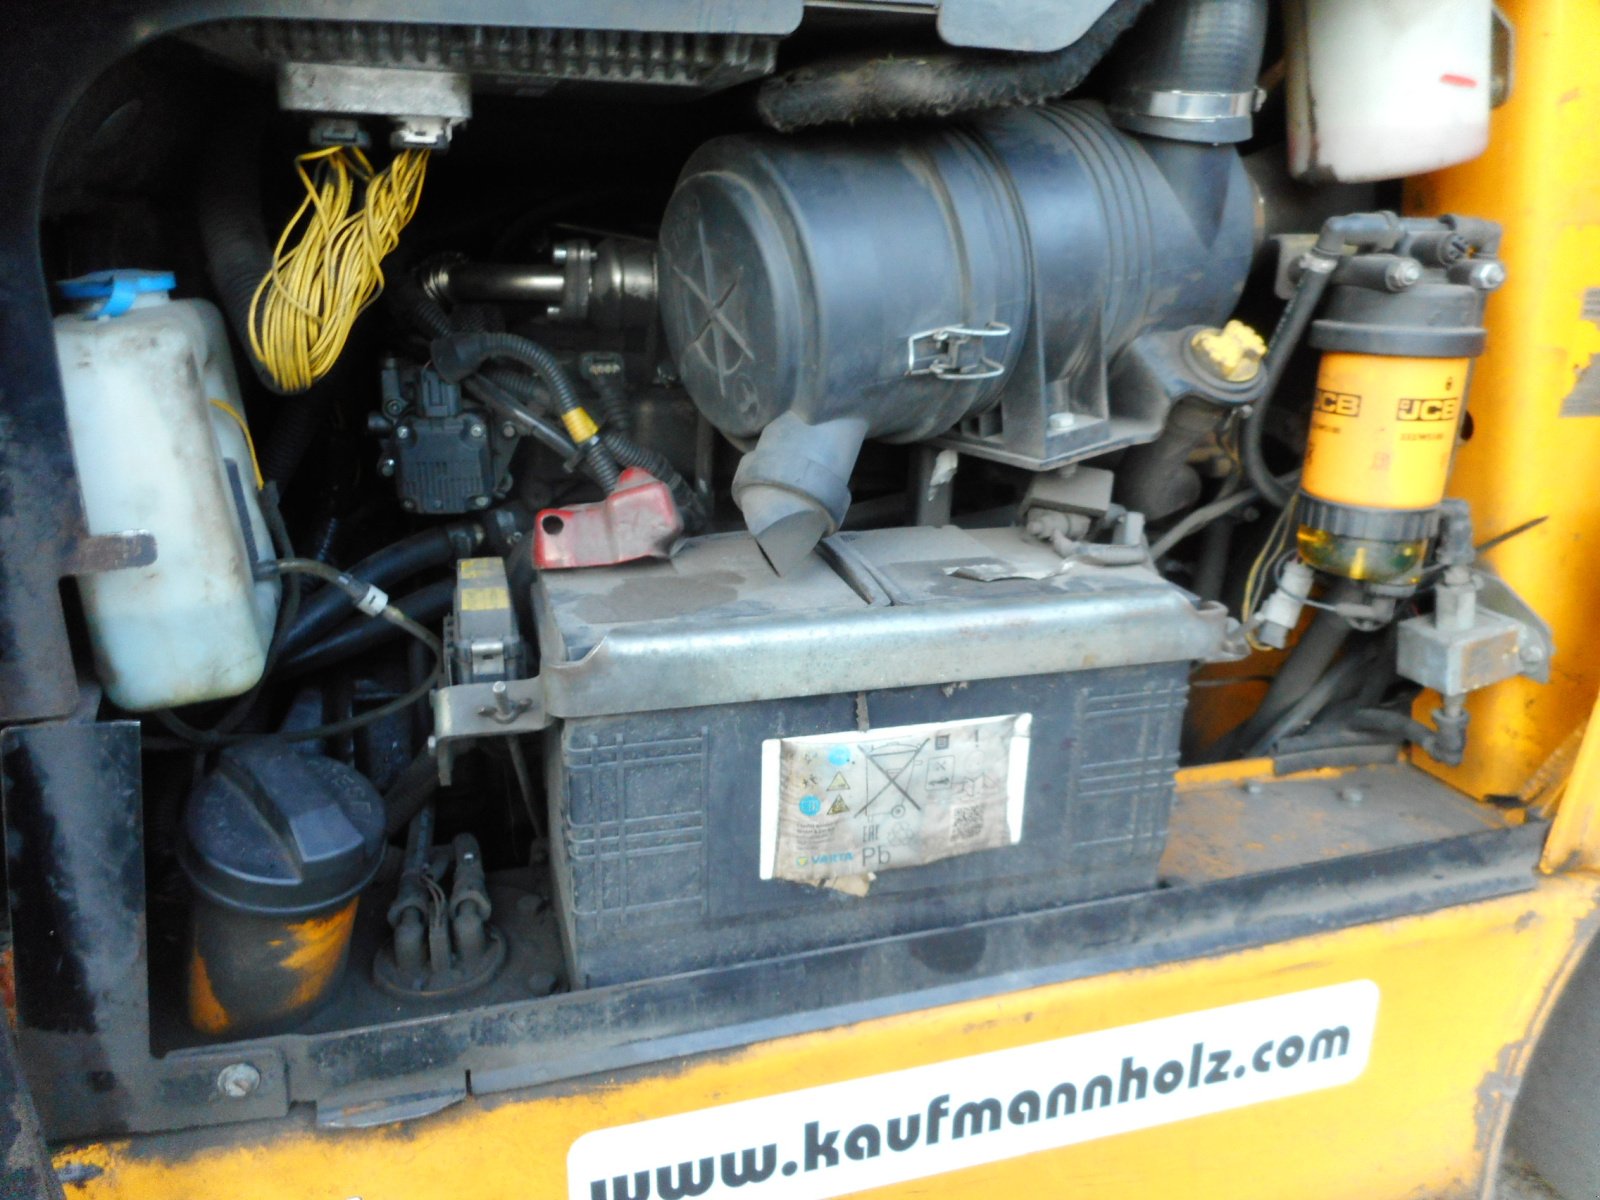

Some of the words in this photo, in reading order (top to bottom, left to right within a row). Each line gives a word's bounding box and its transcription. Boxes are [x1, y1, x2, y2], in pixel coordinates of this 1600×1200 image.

[1396, 397, 1458, 421] JCB
[862, 845, 891, 867] Pb
[590, 1025, 1350, 1200] www.kaufmannholz.com
